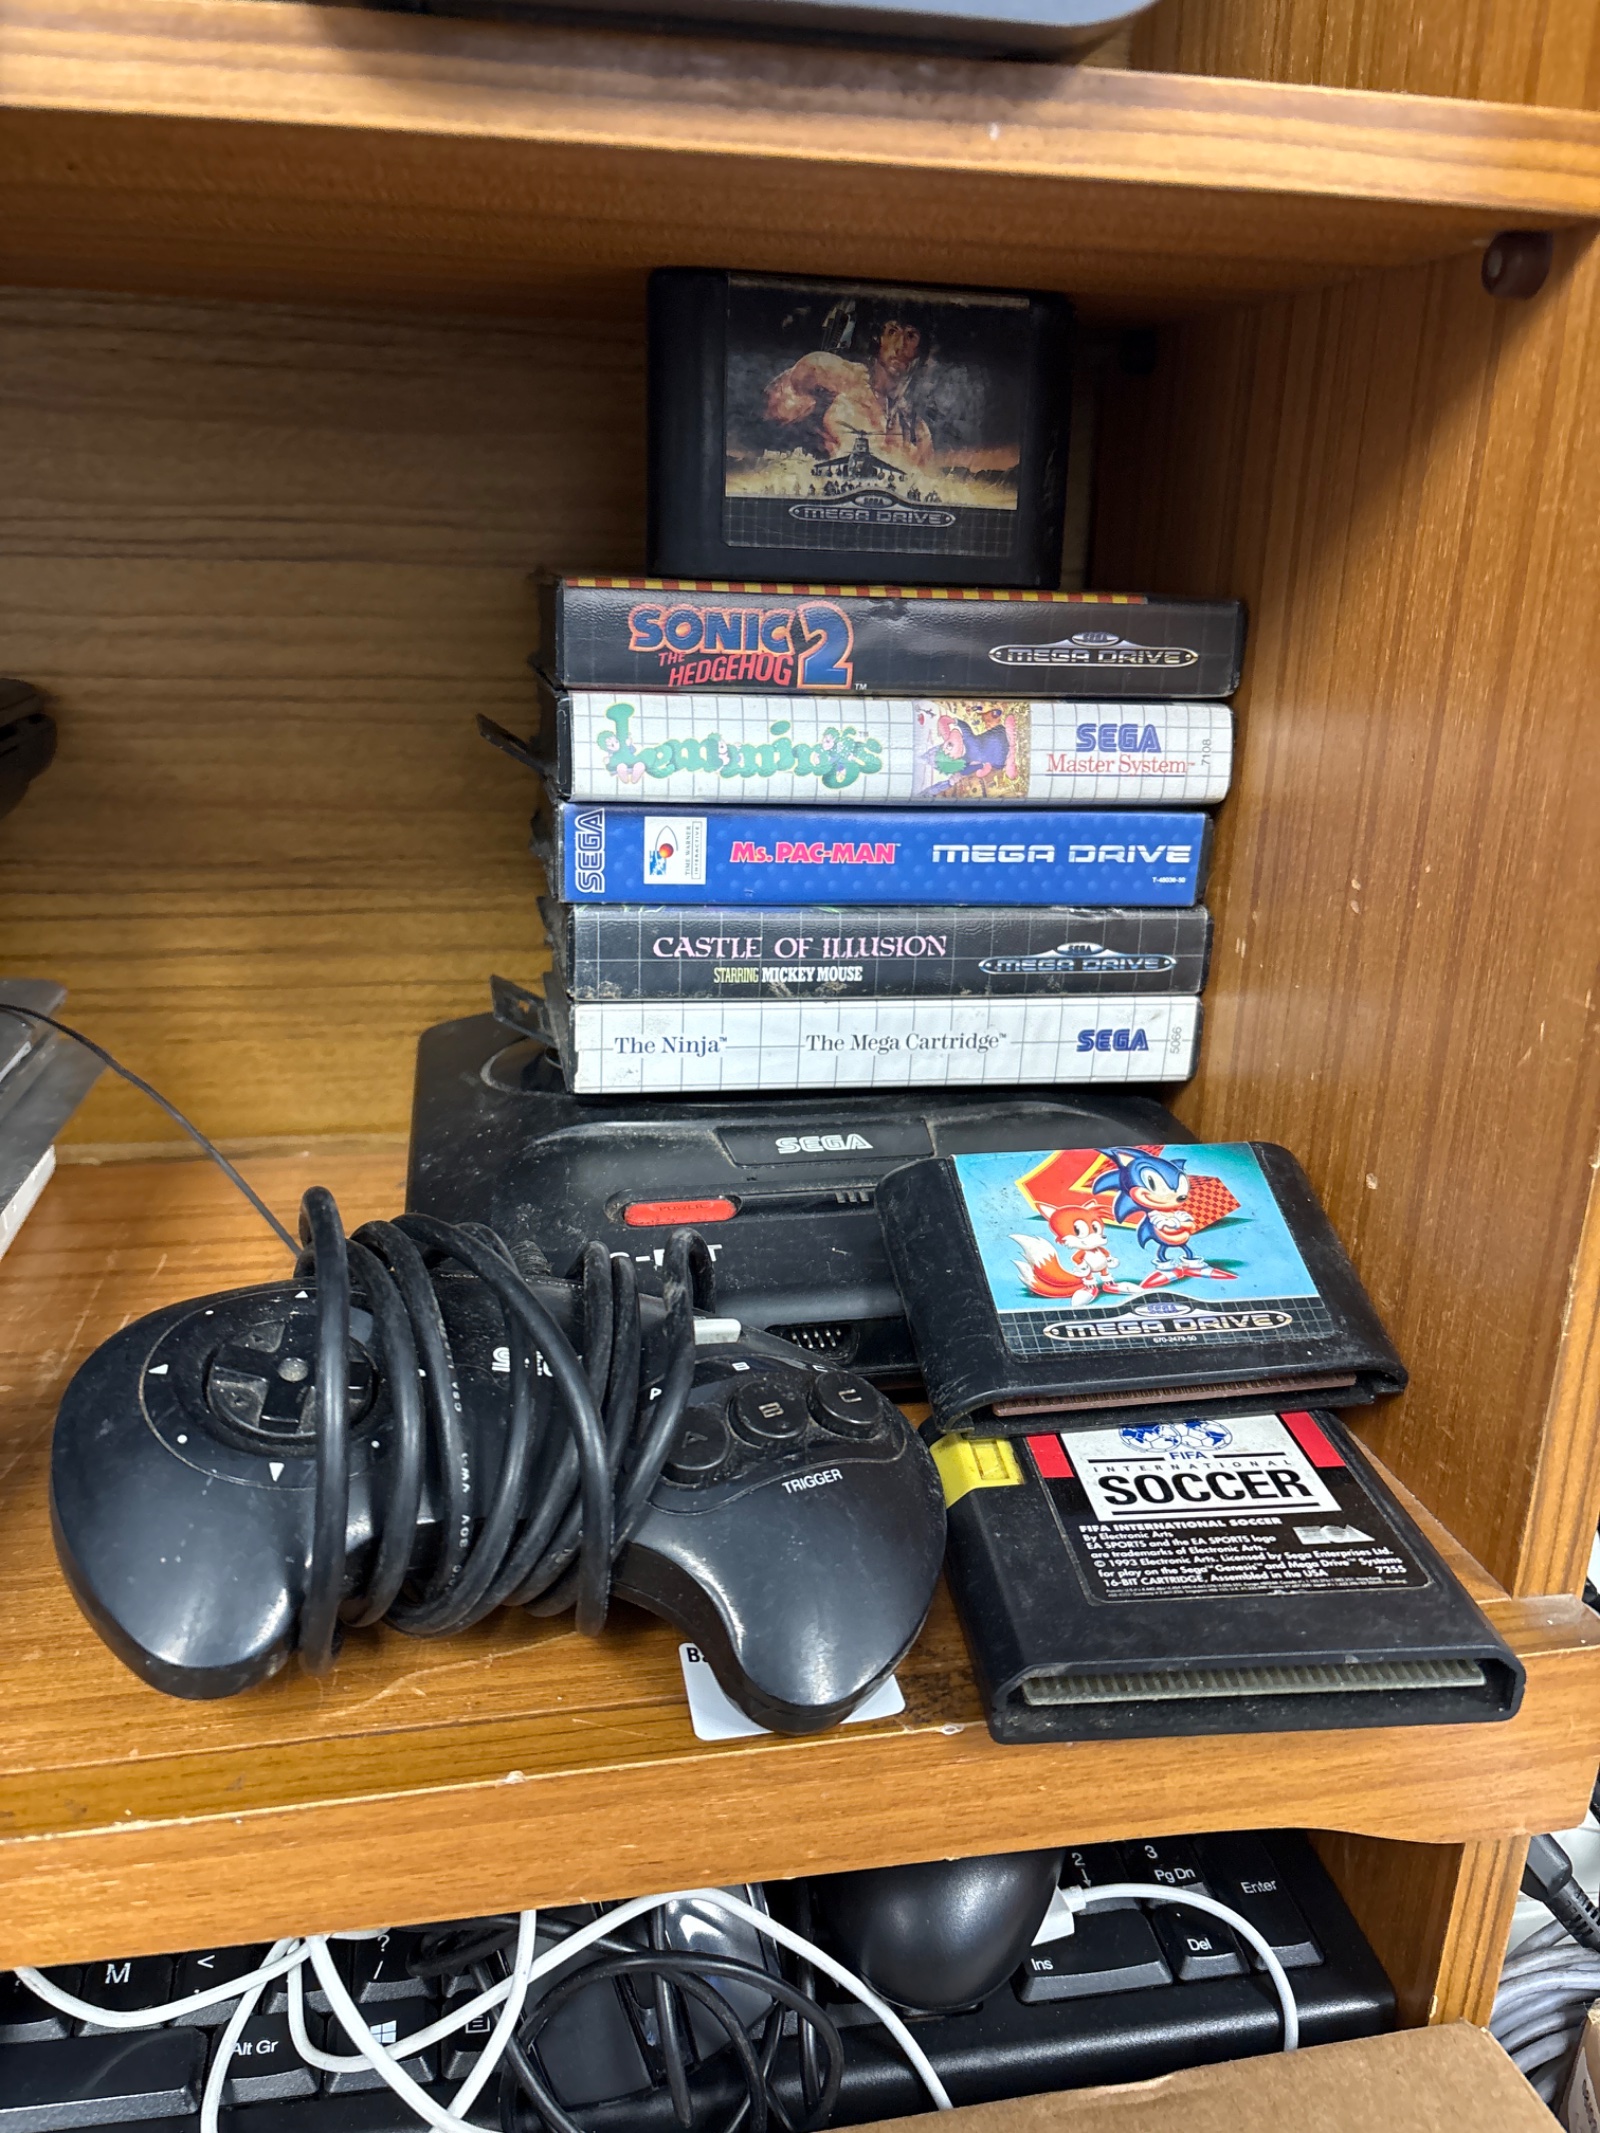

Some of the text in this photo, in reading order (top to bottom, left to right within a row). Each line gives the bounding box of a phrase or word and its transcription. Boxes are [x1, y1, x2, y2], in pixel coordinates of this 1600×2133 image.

[804, 508, 941, 524] MEGA DRIVE
[628, 600, 854, 690] SONIC 2
[658, 651, 687, 667] THE
[1007, 649, 1180, 664] MEGA DRIVE
[668, 654, 794, 687] HEDGEHOG
[1076, 723, 1161, 753] SEGA
[1201, 738, 1212, 766] 7108
[1046, 754, 1115, 774] Master
[575, 808, 605, 893] SEGA
[730, 841, 773, 863] Ms.
[932, 844, 1192, 863] MEGA DRIVE
[652, 935, 946, 959] CASTLE OF ILLUSION
[1068, 944, 1091, 953] SEGA
[997, 958, 1159, 971] MEGA DRIVE
[713, 965, 863, 983] STARRING MICKEY MOUSE
[614, 1037, 655, 1054] The
[806, 1034, 844, 1051] The
[850, 1034, 900, 1055] Mega
[1076, 1028, 1149, 1052] SEGA
[1170, 1026, 1182, 1055] 5066
[775, 1133, 874, 1154] SEGA
[1065, 1313, 1273, 1338] MEGA DRIVE
[1169, 1451, 1208, 1460] FIFA
[1093, 1459, 1292, 1473] INTERNATIONAL
[782, 1468, 843, 1494] TRIGGER
[1098, 1469, 1313, 1505] SOCCER
[1078, 1517, 1283, 1533] FIFA INTERNATIONAL SOCCER
[1082, 1530, 1174, 1543] By Electronic Arts
[1086, 1534, 1277, 1550] EA SPORTS and the EA SPORTS logo
[1094, 1547, 1394, 1568] © 1993 Electronic Arts. Licensed by Sega Enterprises Ltd.
[1112, 1549, 1174, 1558] trademarks
[1175, 1547, 1187, 1555] of
[1189, 1545, 1239, 1555] Electronic
[1241, 1544, 1267, 1552] Arts.
[1098, 1569, 1115, 1578] for
[1117, 1568, 1141, 1579] play
[1144, 1568, 1158, 1576] on
[1160, 1566, 1178, 1575] the
[1264, 1561, 1286, 1570] and
[1287, 1559, 1318, 1570] Mega
[1358, 1556, 1402, 1566] Systems
[1376, 1565, 1407, 1574] 7255
[1103, 1577, 1138, 1587] 16-BIT
[1211, 1571, 1268, 1583] Assembled
[1270, 1570, 1280, 1579] in
[1283, 1569, 1302, 1579] the
[1304, 1568, 1328, 1578] USA
[1071, 1852, 1085, 1867] 2
[1145, 1845, 1158, 1859] 3
[1154, 1867, 1196, 1883] Pg Dn
[1240, 1879, 1278, 1895] Enter
[377, 1934, 390, 1952] ?
[1187, 1937, 1213, 1951] Del
[105, 1962, 131, 1984] M
[1031, 1957, 1054, 1971] Ins
[231, 2040, 278, 2056] Alt Gr
